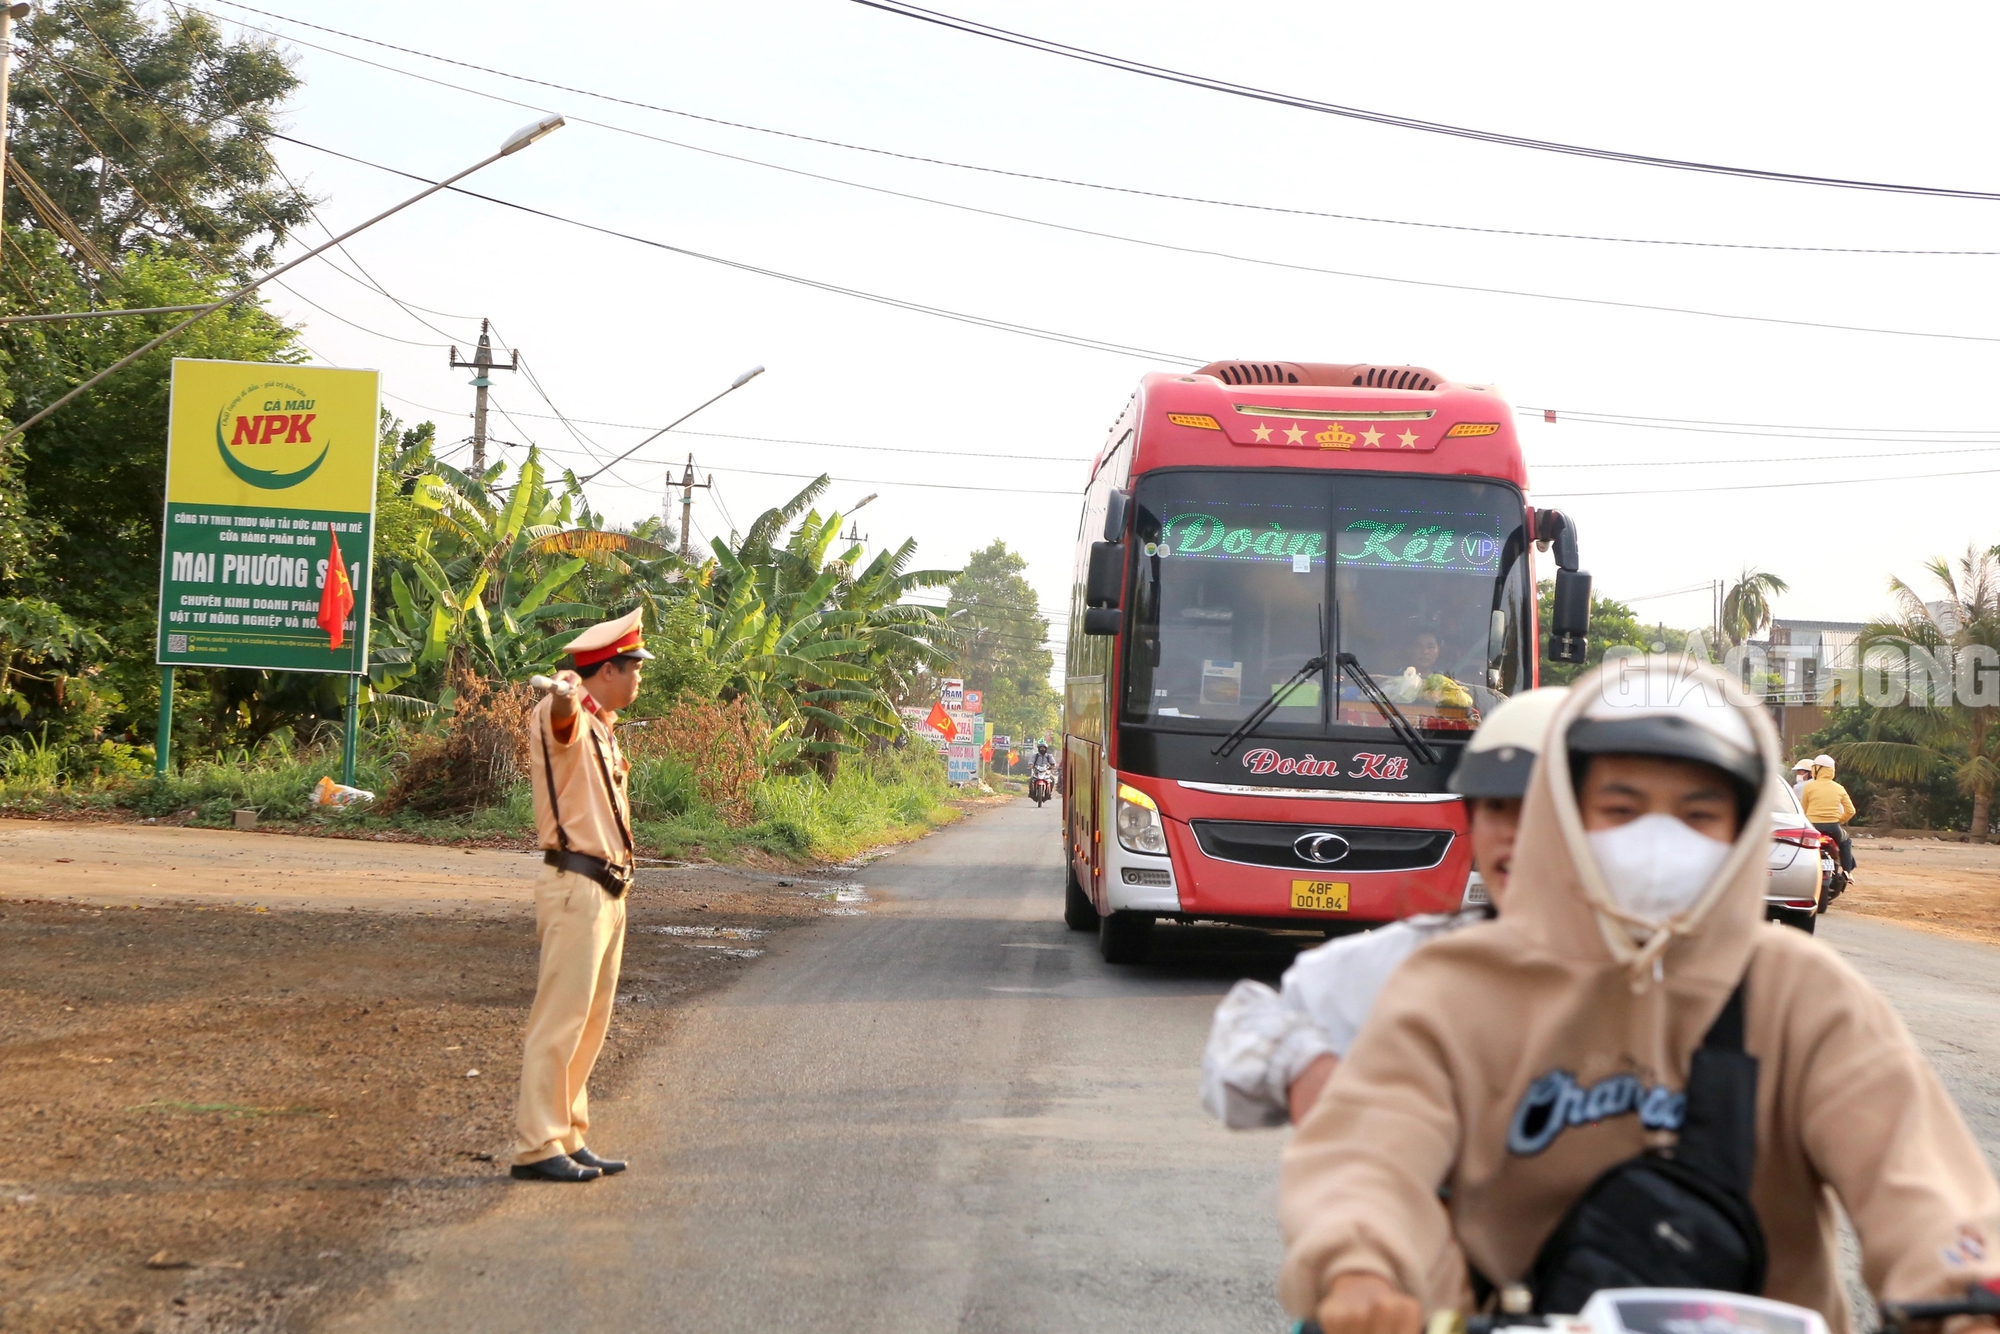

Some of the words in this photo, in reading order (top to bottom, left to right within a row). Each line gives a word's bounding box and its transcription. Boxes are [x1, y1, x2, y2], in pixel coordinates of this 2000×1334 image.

[263, 398, 281, 412] CÀ
[284, 399, 316, 411] MAU
[231, 414, 316, 445] NPK
[174, 511, 197, 524] CÔNG
[199, 514, 209, 525] TY
[210, 515, 232, 526] TNHH
[234, 516, 258, 527] TMDV
[259, 516, 276, 530] VẬN
[277, 516, 291, 529] TẢI
[292, 518, 310, 530] ĐỨC
[311, 521, 329, 531] ANH
[330, 521, 347, 532] BAN
[219, 529, 239, 542] CỬA
[241, 531, 267, 544] HÀNG
[268, 533, 294, 545] PHÂN
[296, 534, 316, 546] BÓN
[1164, 512, 1327, 558] Đoàn
[1338, 519, 1456, 564] Kết
[1464, 538, 1494, 557] VIP
[171, 551, 216, 583] MAI
[222, 553, 309, 588] PHƯƠNG
[315, 558, 330, 589] S
[350, 561, 360, 591] 1
[180, 594, 222, 607] CHUYÊN
[224, 597, 250, 609] KINH
[253, 598, 289, 611] DOANH
[291, 599, 319, 612] PHÂN
[169, 609, 191, 625] VẬT
[192, 611, 207, 623] TƯ
[209, 611, 240, 625] NÔNG
[242, 614, 283, 629] NGHIỆP
[285, 615, 299, 628] VÀ
[1242, 748, 1340, 777] Đoàn
[1348, 752, 1409, 781] Kết
[1307, 882, 1333, 895] 48F
[1297, 895, 1342, 909] 001.84
